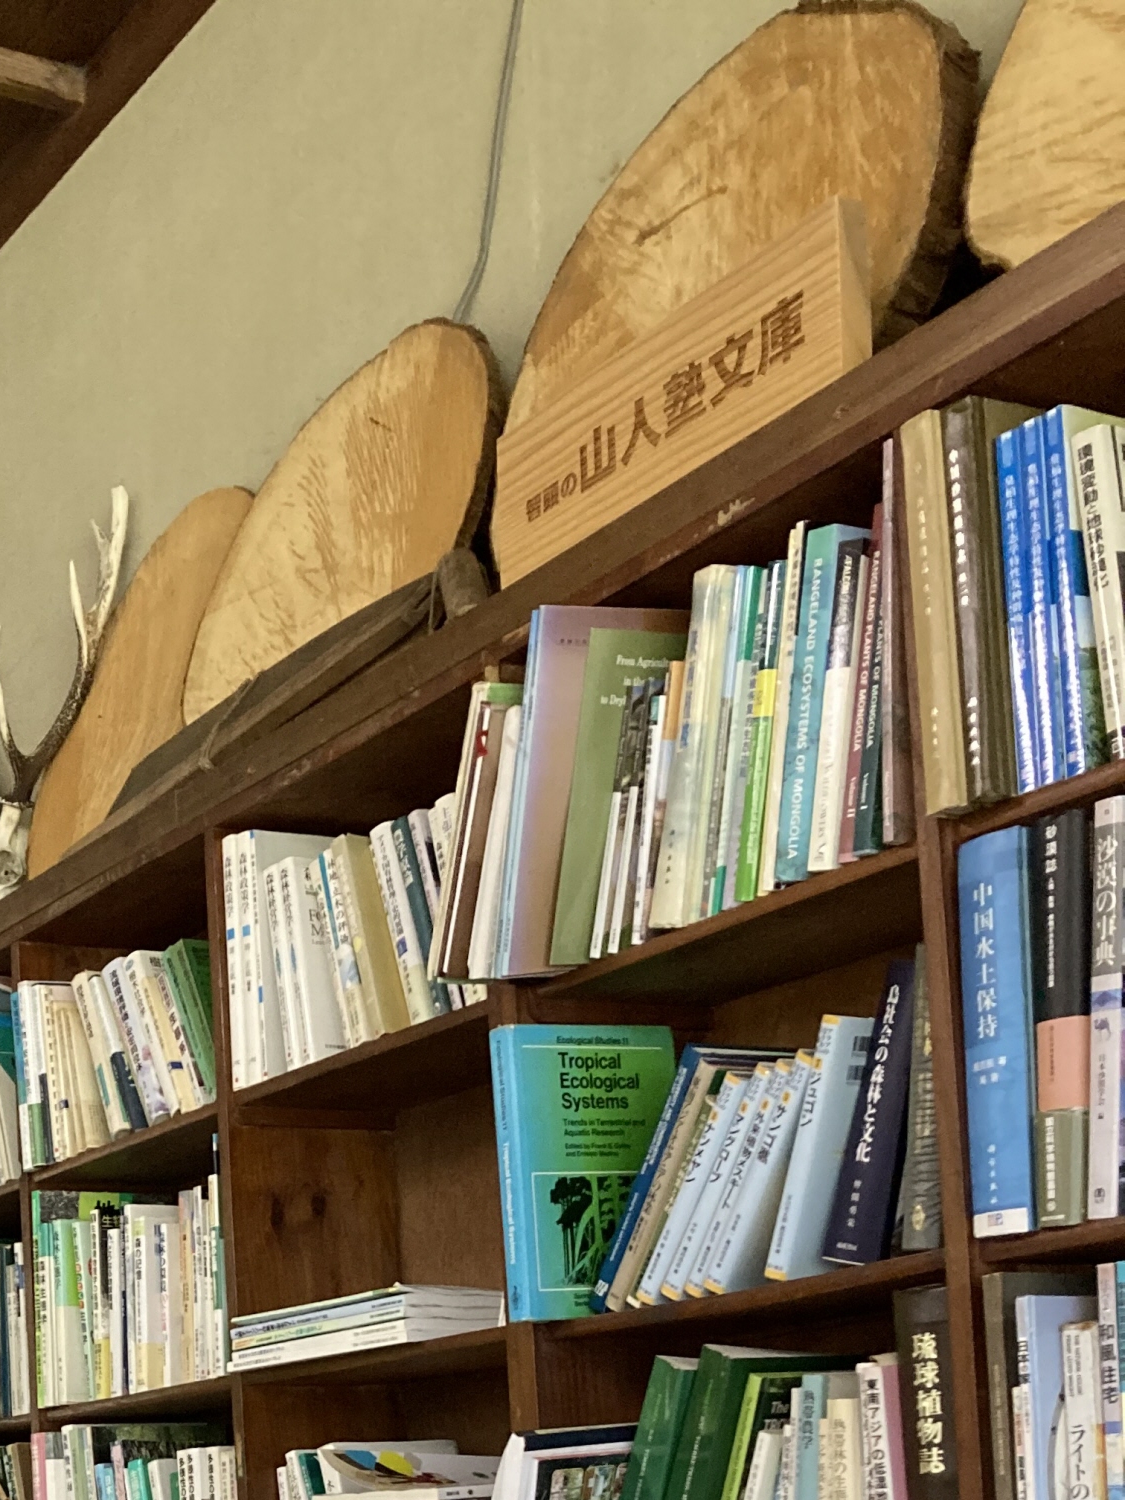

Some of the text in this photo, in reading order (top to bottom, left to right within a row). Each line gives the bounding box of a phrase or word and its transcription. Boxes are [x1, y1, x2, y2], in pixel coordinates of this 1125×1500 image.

[860, 670, 869, 684] OF
[861, 624, 874, 666] PLANTS
[786, 557, 824, 860] RANGELAND ECOSYSTEMS OF MONGOLIA
[854, 689, 868, 752] MONGOLIA
[1095, 834, 1118, 967] 沙漠の事典
[973, 882, 998, 1039] 中国水土保持
[558, 1052, 621, 1072] Tropical
[560, 1073, 639, 1093] Ecological
[856, 984, 900, 1163] 島社会の森林と文化
[561, 1093, 629, 1112] Systems
[709, 1113, 744, 1183] マングローブ
[912, 1332, 946, 1474] 琉球植物誌
